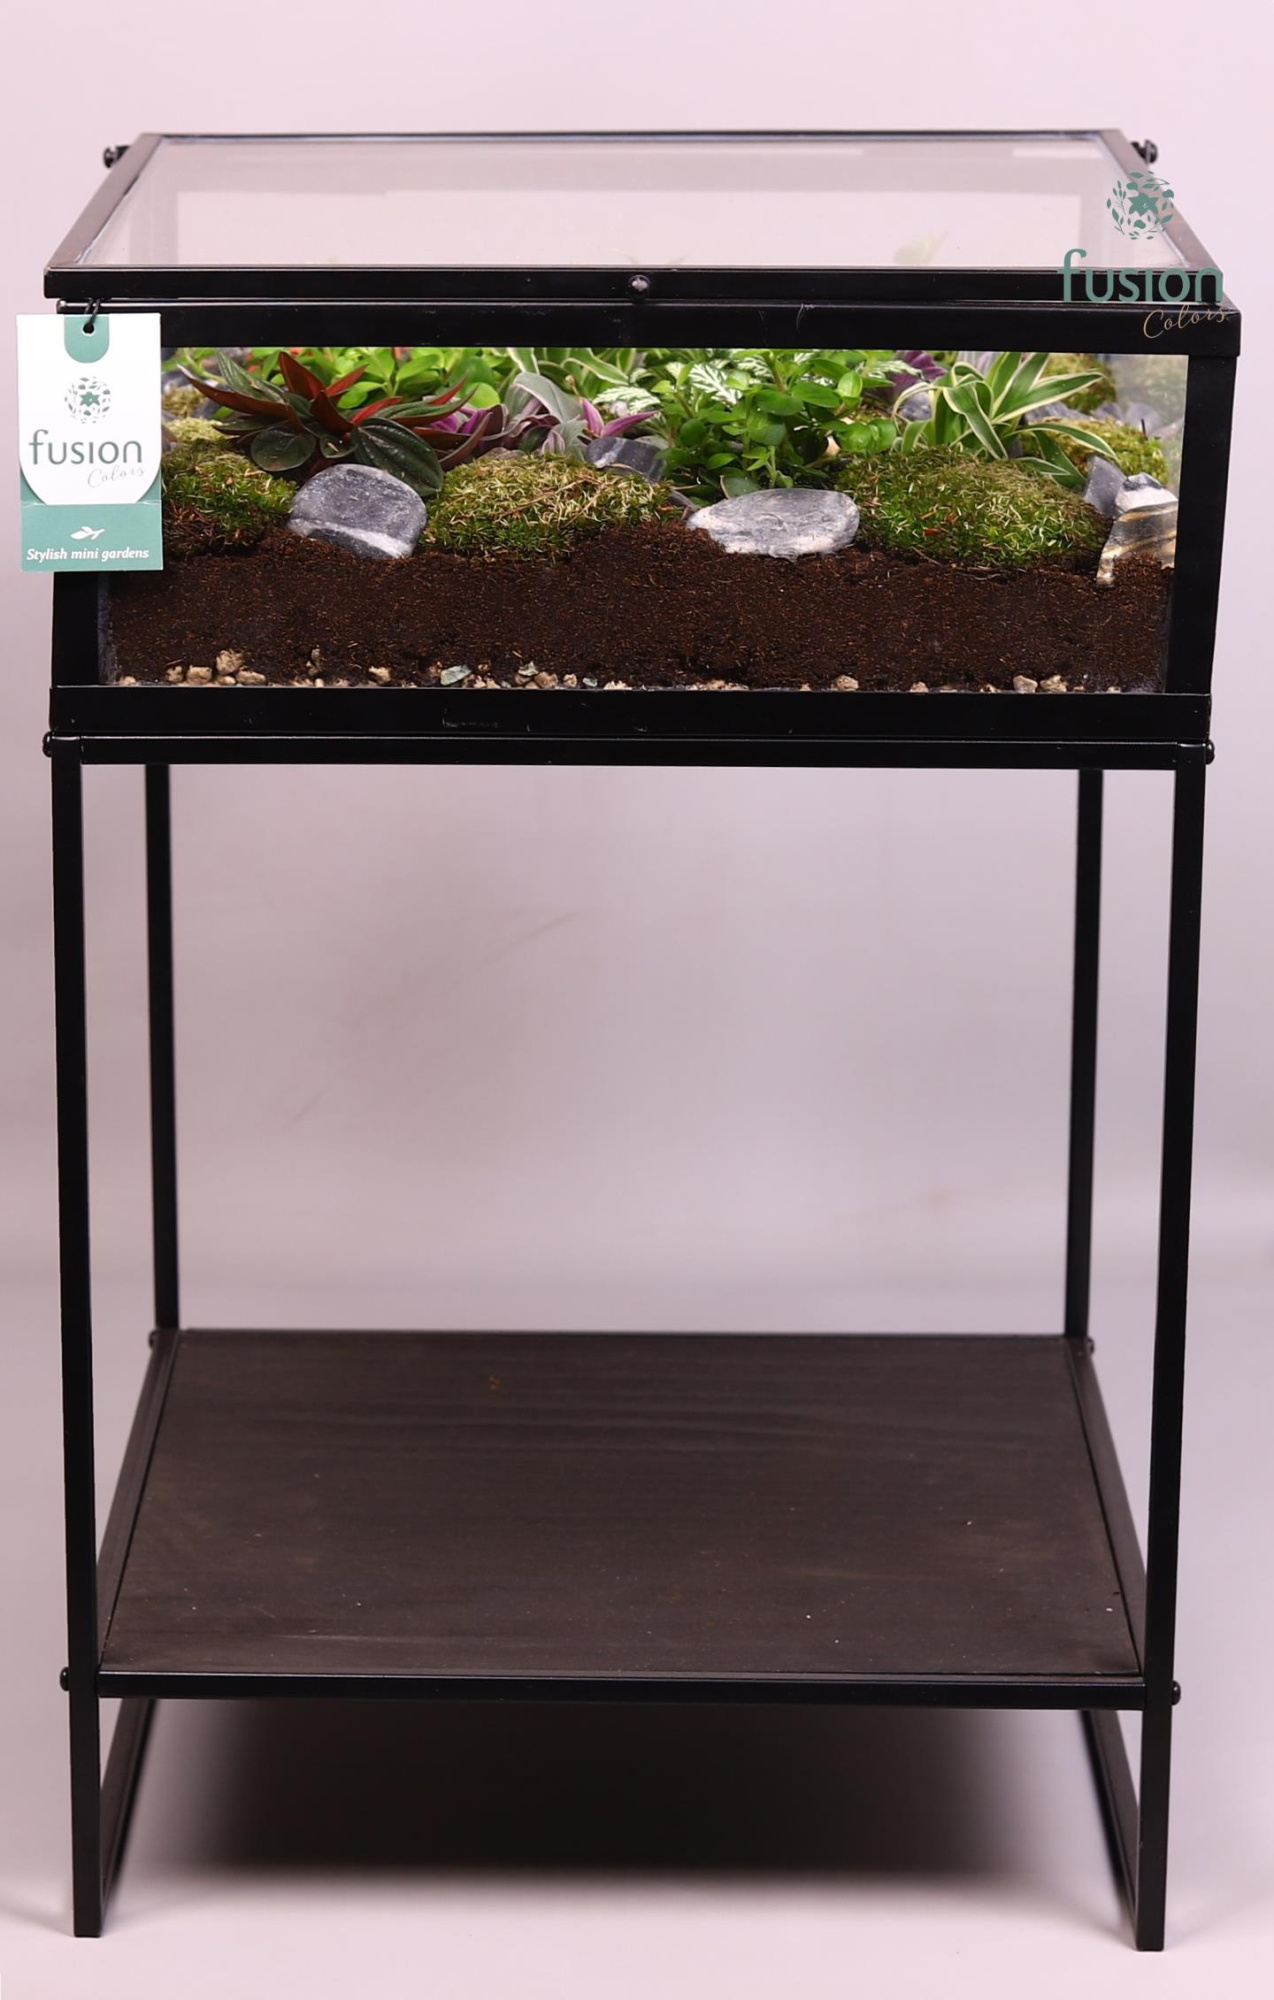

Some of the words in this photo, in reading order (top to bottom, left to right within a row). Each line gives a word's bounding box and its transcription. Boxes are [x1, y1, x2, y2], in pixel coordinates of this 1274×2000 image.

[28, 429, 143, 465] fusion
[87, 465, 147, 488] Colors
[26, 547, 68, 563] Stylish
[70, 547, 99, 559] mini
[101, 547, 149, 562] gardens
